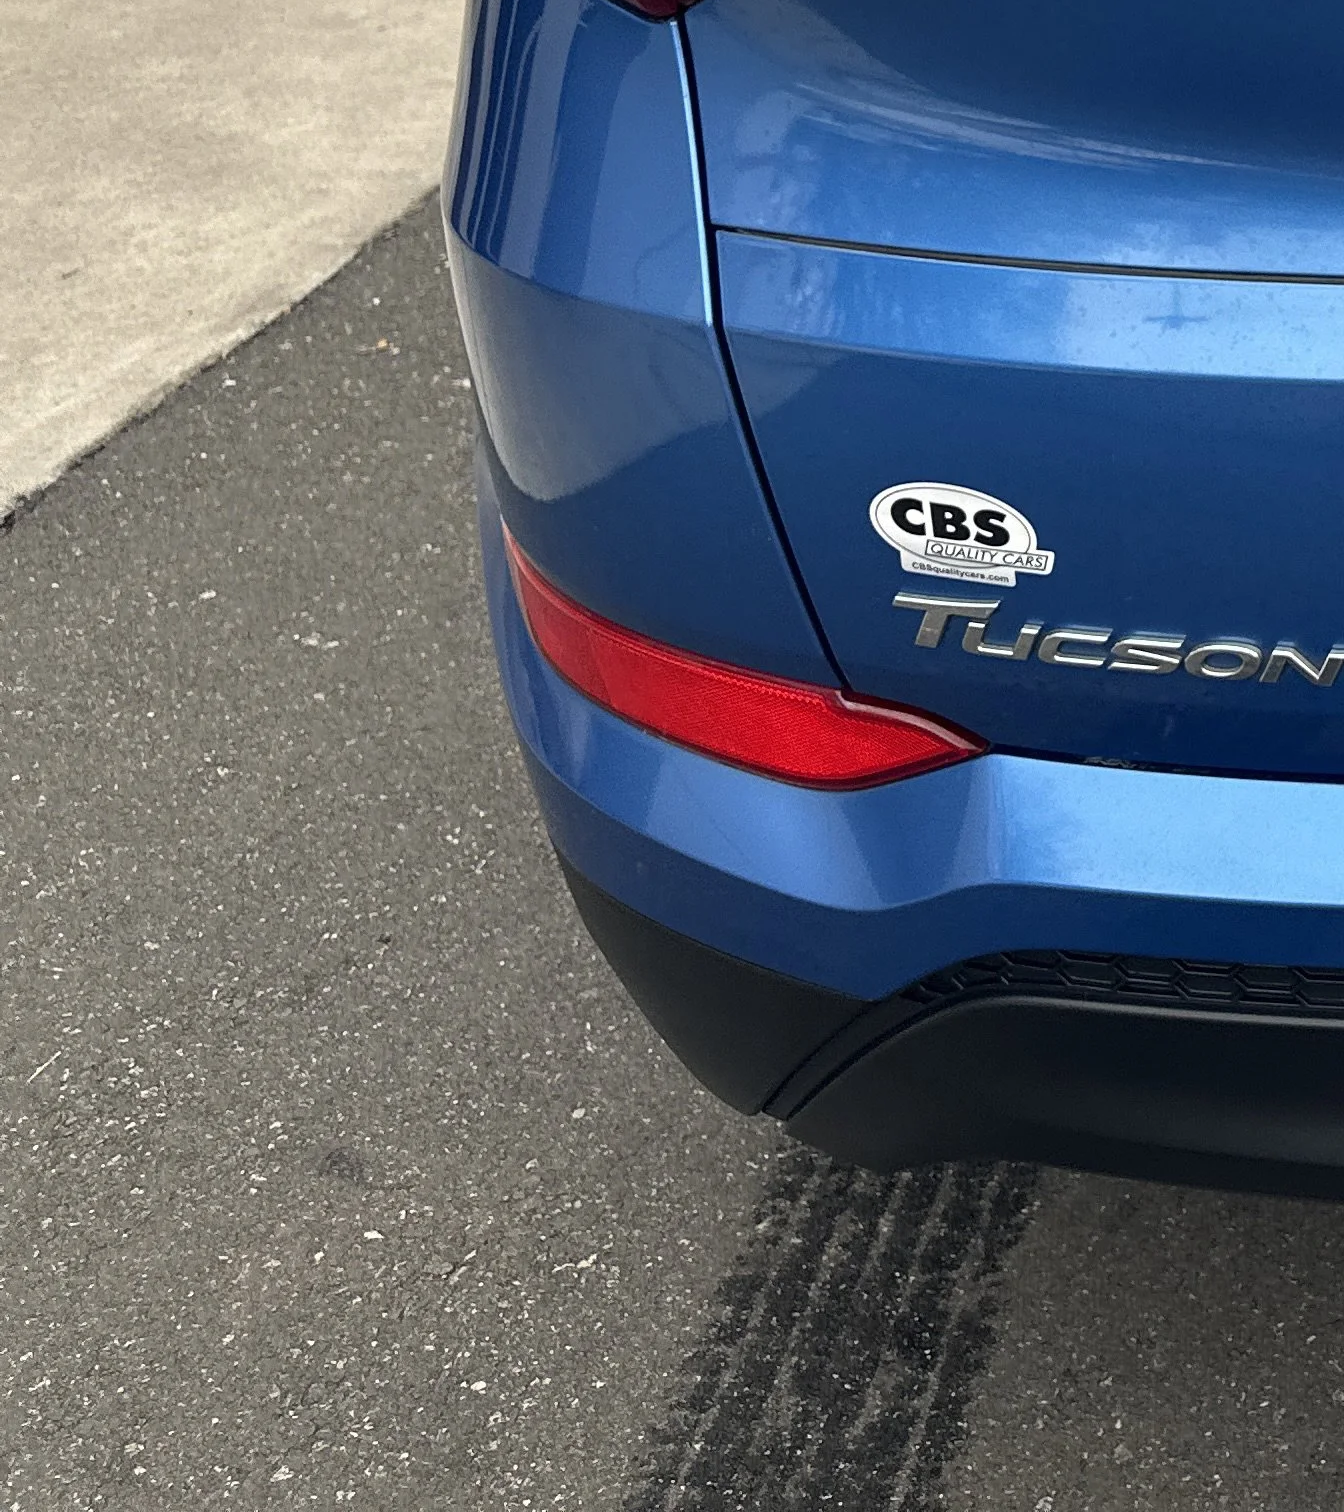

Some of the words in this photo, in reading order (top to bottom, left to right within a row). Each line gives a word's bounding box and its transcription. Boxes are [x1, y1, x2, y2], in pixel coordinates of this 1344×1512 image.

[890, 497, 1010, 547] CBS
[930, 543, 998, 563] QUALITY
[1002, 553, 1043, 569] CARS
